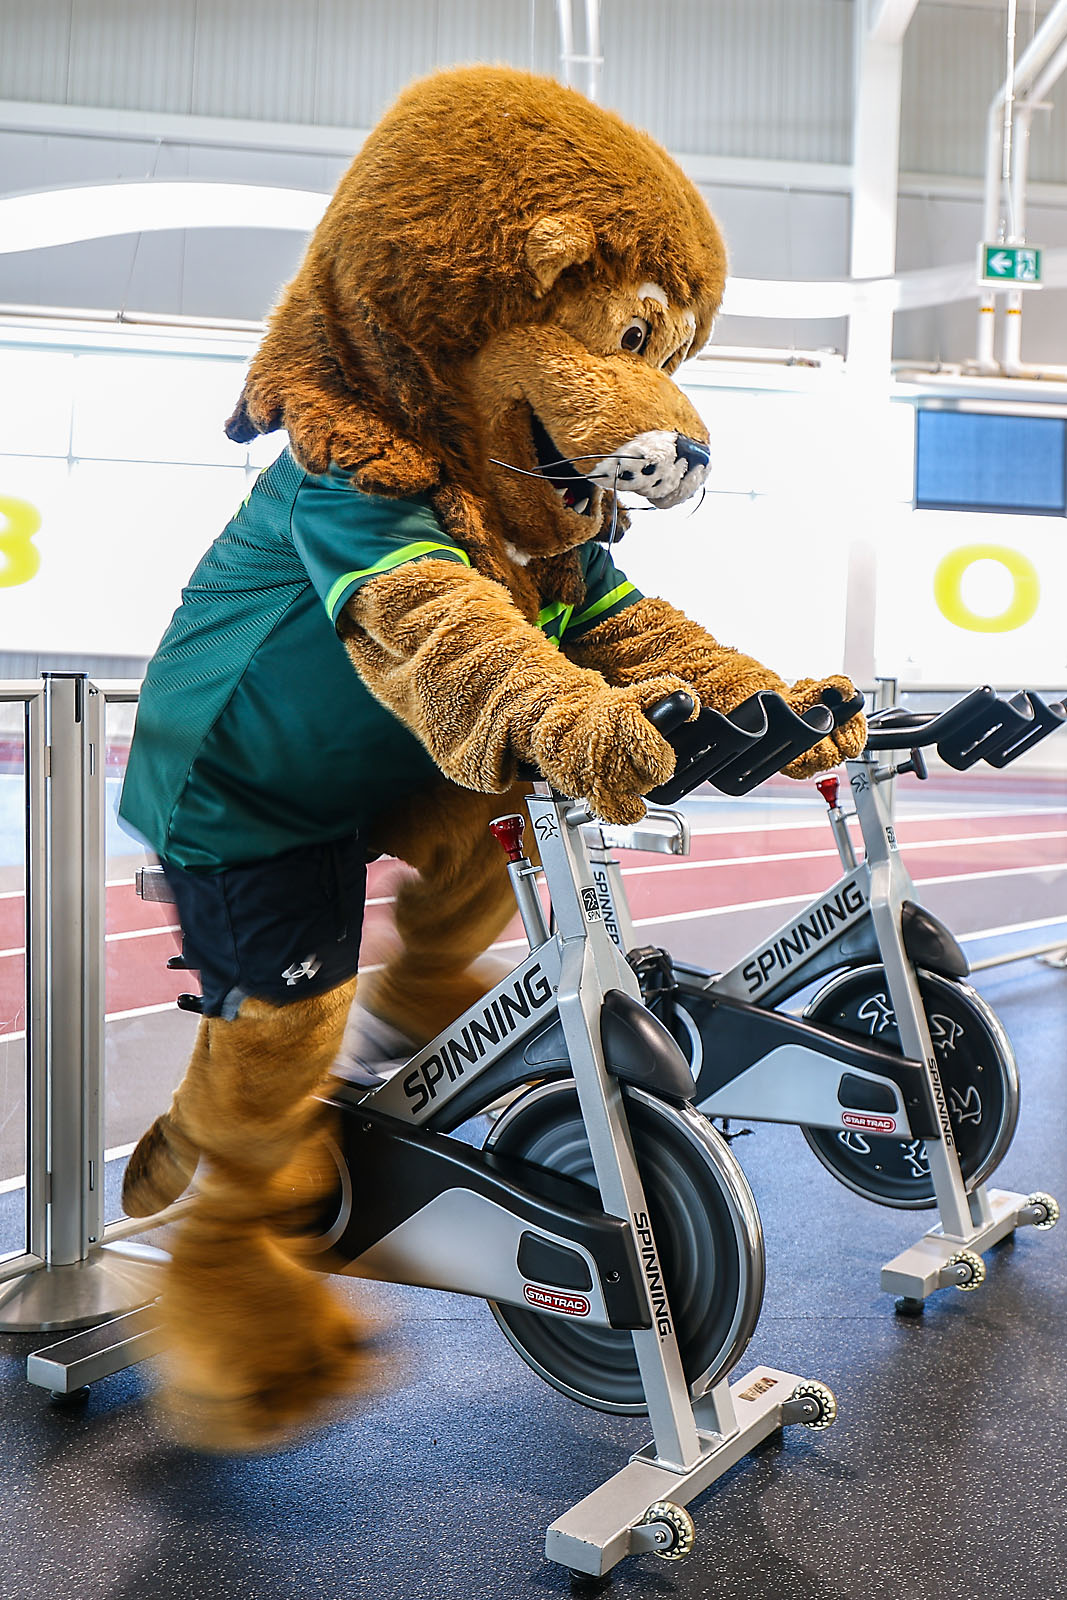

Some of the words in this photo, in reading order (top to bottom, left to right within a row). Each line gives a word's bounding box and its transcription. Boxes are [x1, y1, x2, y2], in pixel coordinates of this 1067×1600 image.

[845, 1116, 866, 1126] STAR
[866, 1119, 891, 1129] TRAC
[527, 1290, 552, 1304] STAR
[553, 1297, 584, 1310] TRAC
